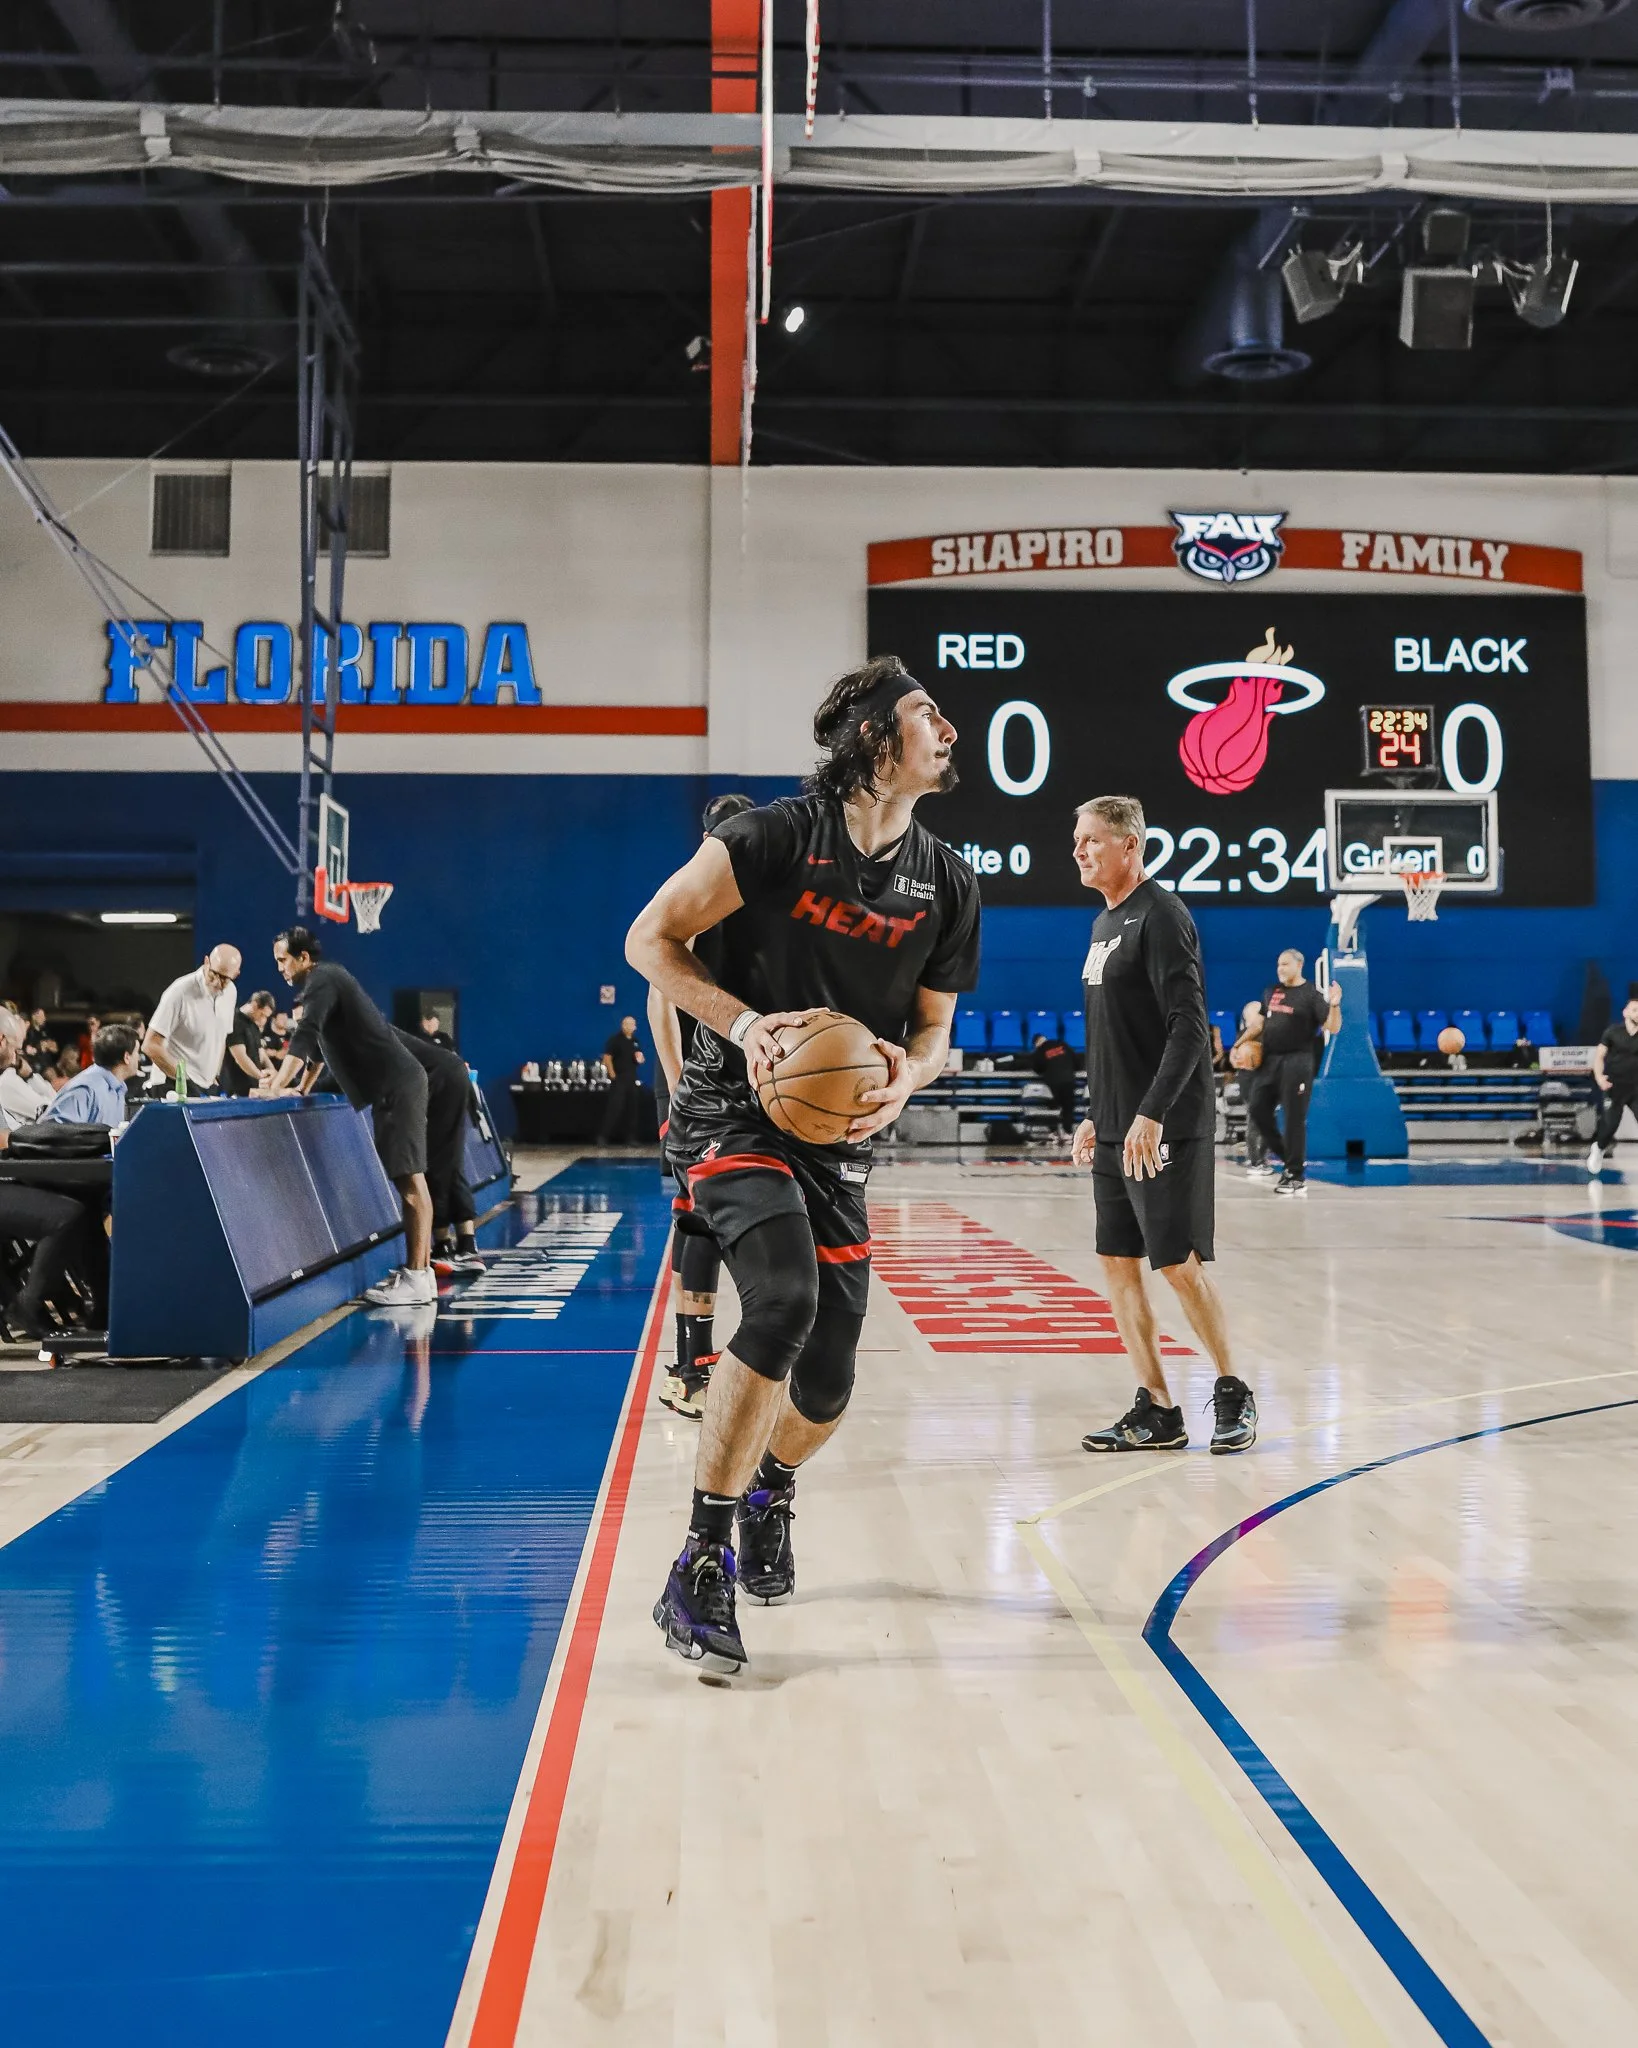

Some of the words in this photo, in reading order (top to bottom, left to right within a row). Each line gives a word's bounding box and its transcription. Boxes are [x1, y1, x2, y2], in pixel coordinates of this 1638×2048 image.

[1174, 513, 1282, 546] FAU
[931, 529, 1123, 575] SHAPIRO
[1341, 532, 1509, 580] FAMILY
[104, 621, 543, 705] FLORIDA
[938, 634, 1025, 669] RED
[1394, 637, 1529, 673] BLACK
[1370, 711, 1428, 732] 22:34
[987, 700, 1050, 796] 0
[1380, 732, 1421, 766] 24
[1442, 703, 1503, 793] 0
[945, 843, 1003, 874] ite
[1009, 844, 1031, 875] 0
[1145, 827, 1327, 893] 22:34
[1467, 845, 1486, 875] 0
[910, 888, 934, 901] Health
[790, 890, 927, 949] HEAT
[461, 1263, 589, 1297] MILES
[437, 1301, 565, 1320] 1.8
